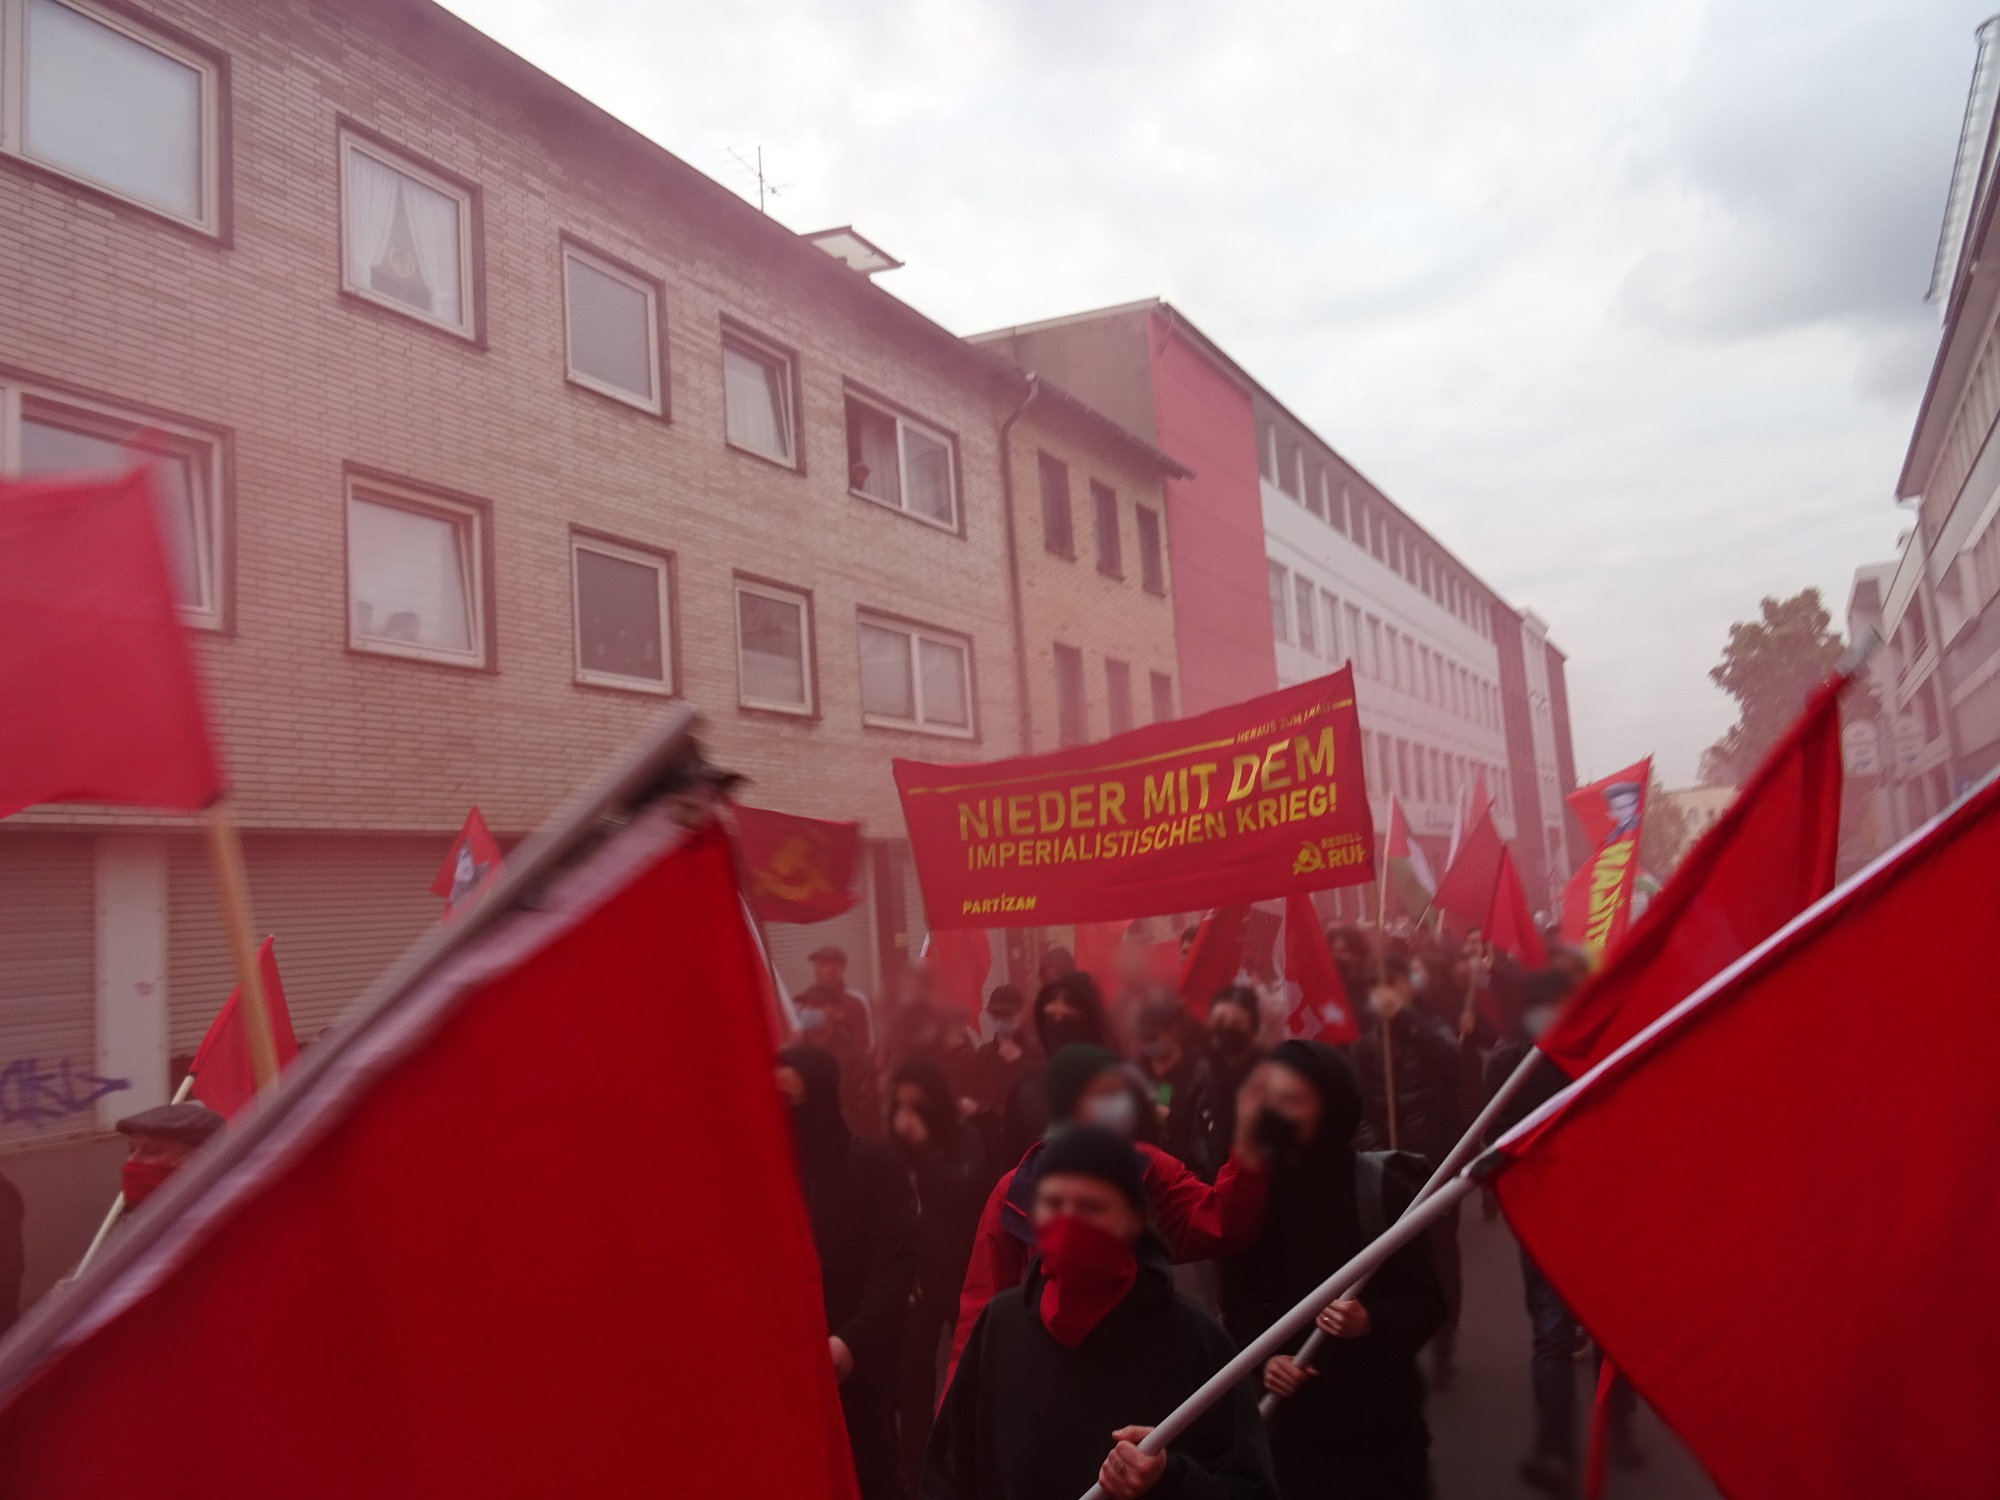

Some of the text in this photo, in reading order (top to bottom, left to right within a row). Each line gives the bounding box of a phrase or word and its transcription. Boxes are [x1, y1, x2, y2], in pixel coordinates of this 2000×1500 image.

[1236, 720, 1277, 745] HERAUS
[1279, 711, 1302, 731] ZUM
[957, 726, 1335, 842] NIEDER MIT DEM
[967, 781, 1338, 871] IMPERIALISTISCHEN KRIEG!
[962, 892, 1037, 915] PARTİZAN
